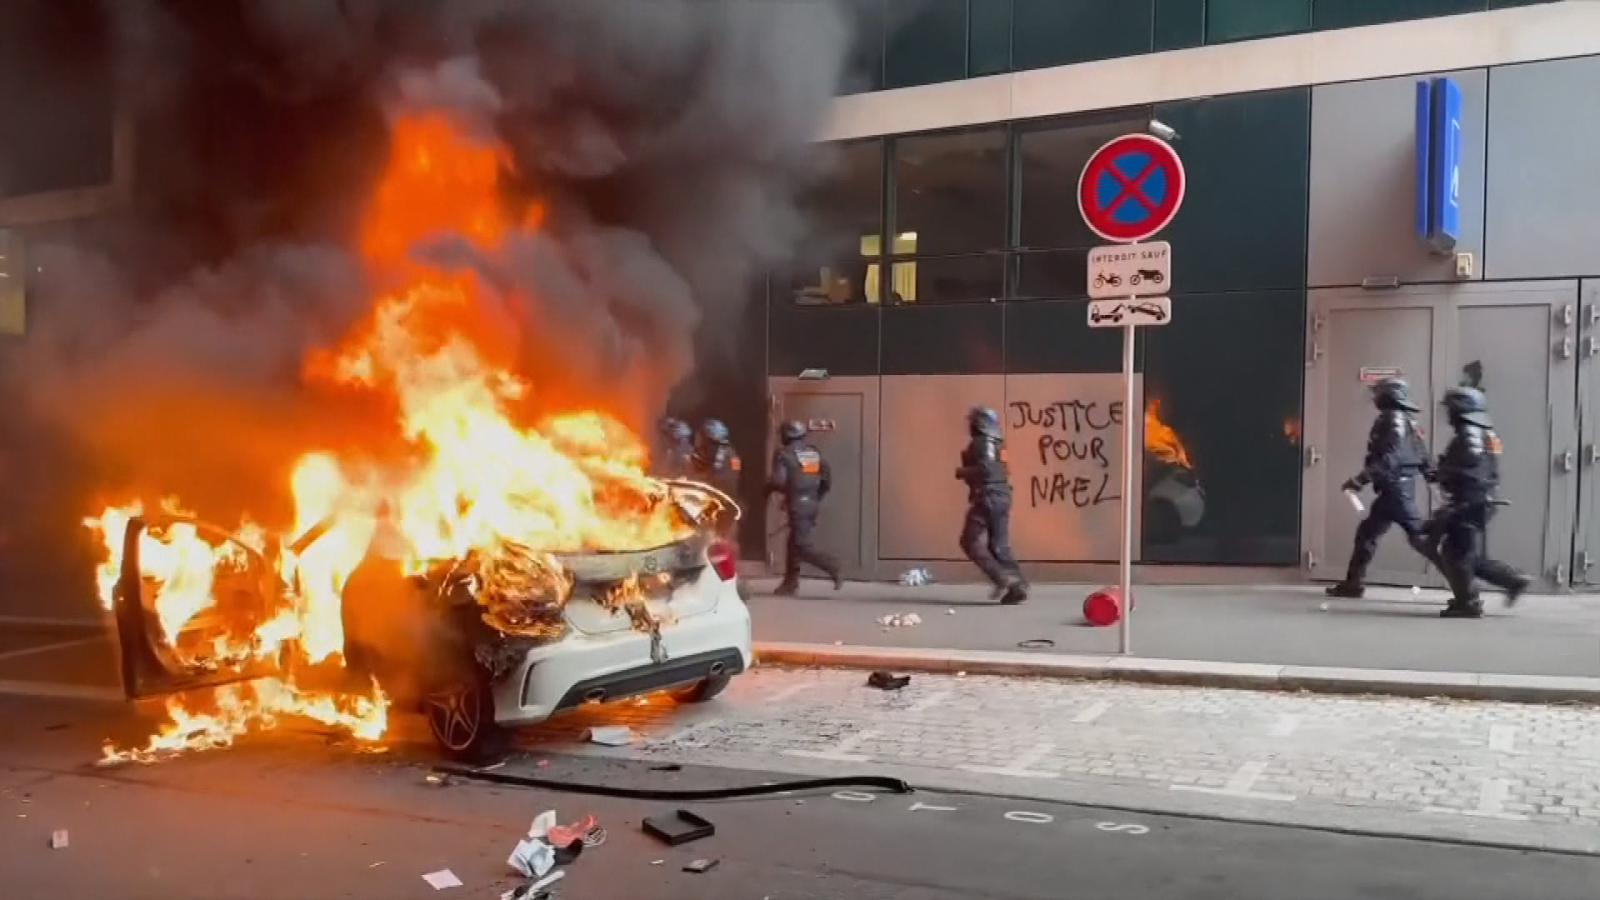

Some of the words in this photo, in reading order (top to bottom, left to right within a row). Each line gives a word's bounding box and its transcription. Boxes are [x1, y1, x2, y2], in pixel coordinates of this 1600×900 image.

[1141, 249, 1167, 259] SAUF
[1009, 400, 1123, 432] JUSTICE
[1038, 434, 1109, 468] POUR
[1030, 473, 1122, 508] NAEL
[762, 783, 1150, 834] OTOS
